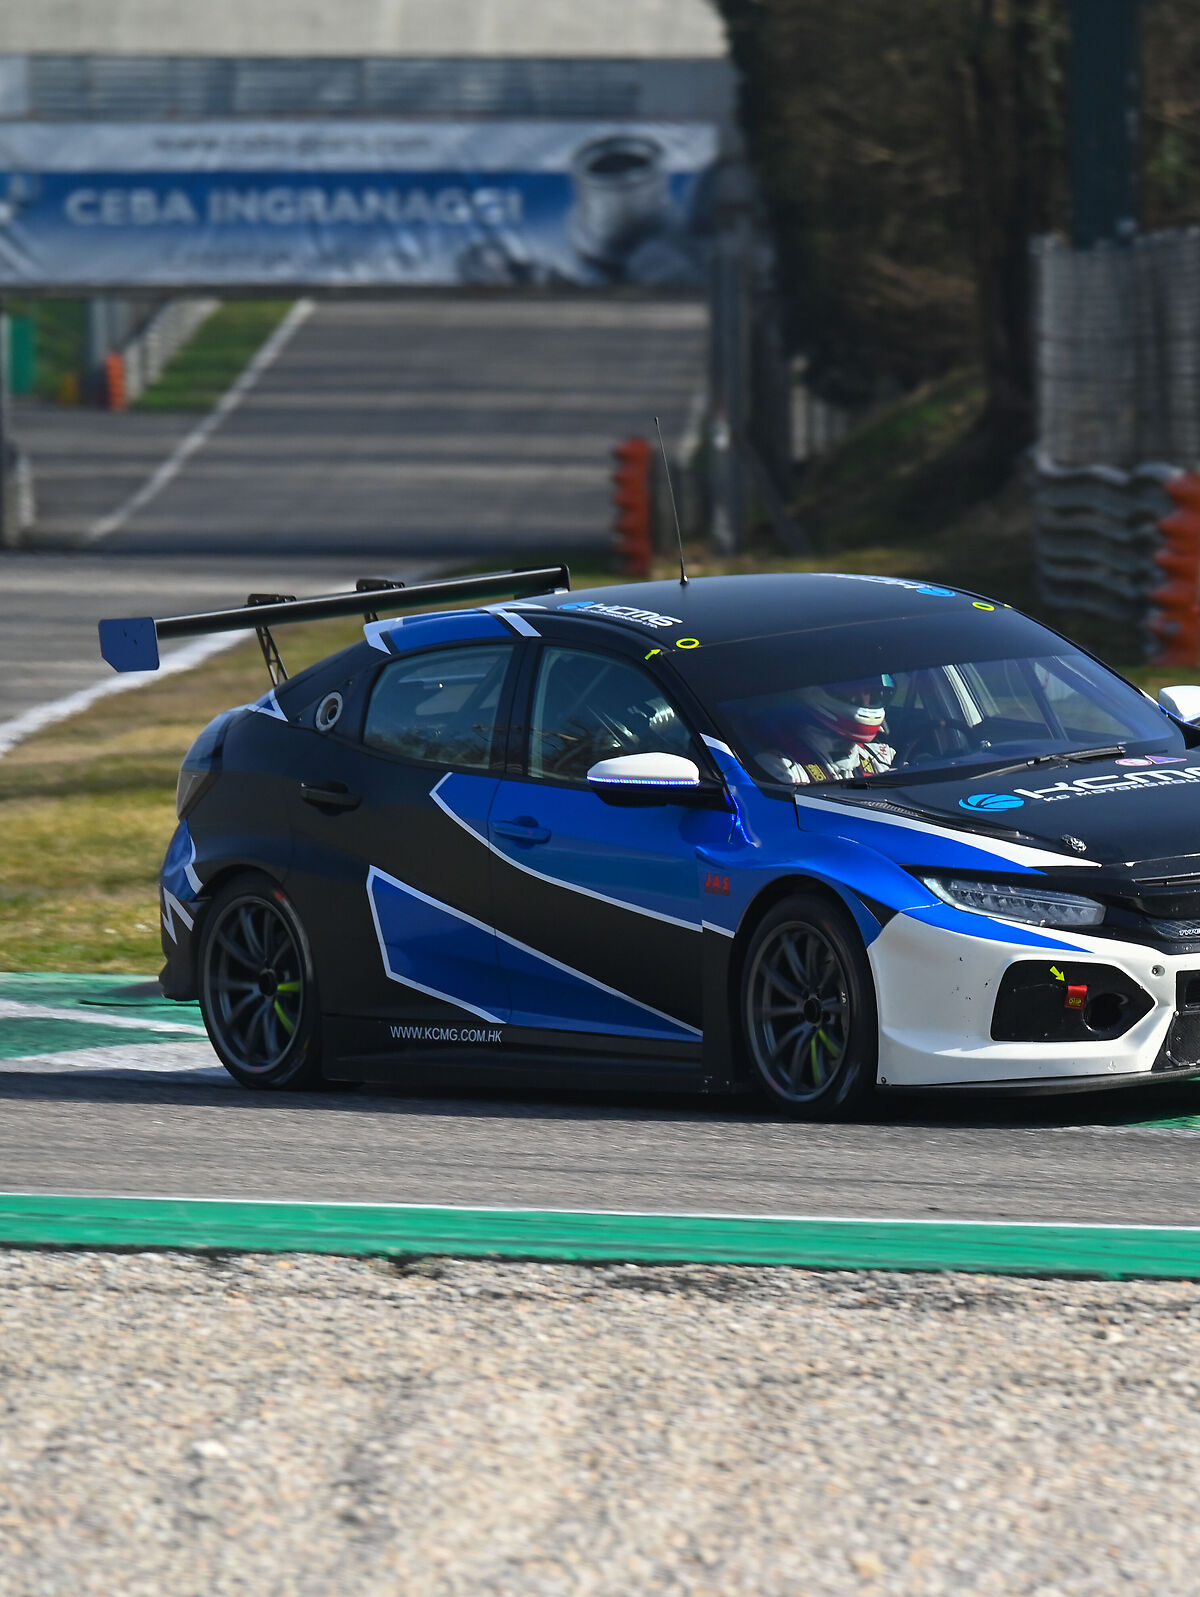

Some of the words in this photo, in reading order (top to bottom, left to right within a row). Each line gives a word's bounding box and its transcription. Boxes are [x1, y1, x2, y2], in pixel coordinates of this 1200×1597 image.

[64, 188, 195, 225] CEBA
[583, 603, 683, 627] KCMG
[390, 1025, 502, 1042] WWW.KCMG.COM.HK
